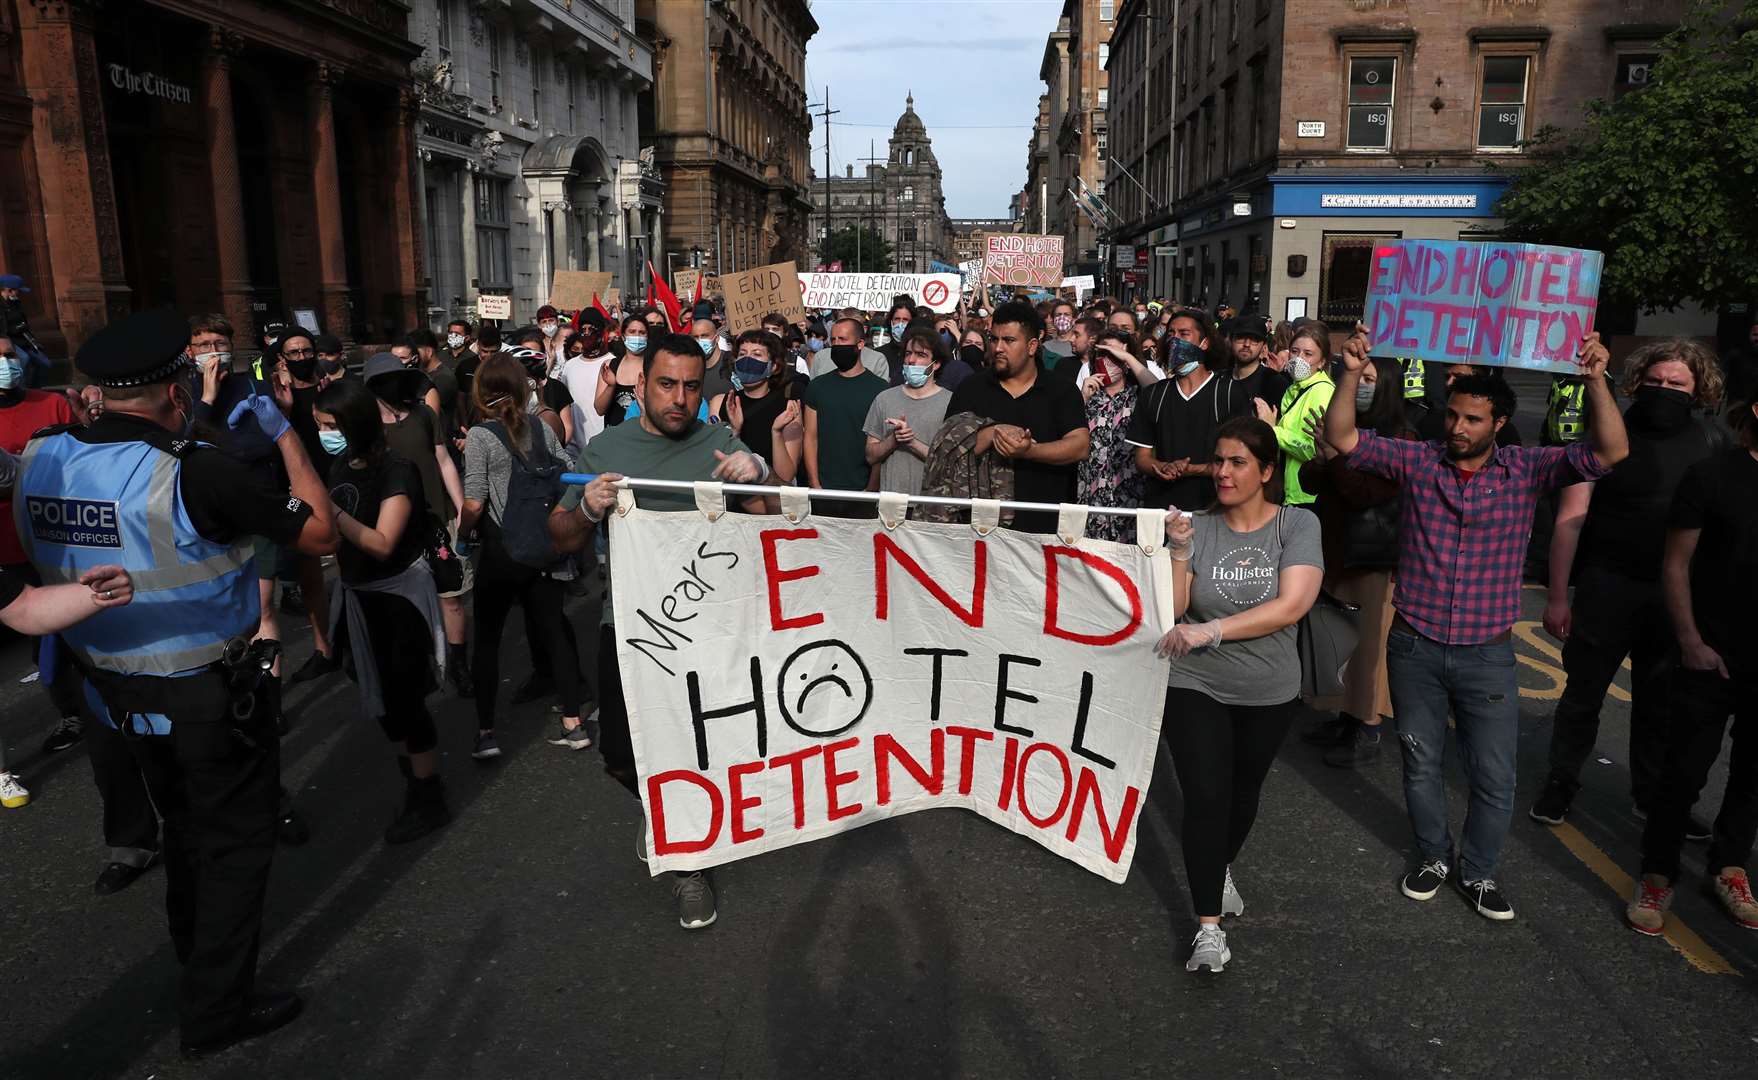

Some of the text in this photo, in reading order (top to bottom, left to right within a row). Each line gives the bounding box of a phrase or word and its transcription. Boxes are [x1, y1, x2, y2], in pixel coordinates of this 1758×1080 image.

[109, 63, 192, 104] The Citizen
[988, 237, 1064, 253] END HOTEL
[986, 253, 1063, 268] DETENTION
[739, 271, 781, 294] END
[811, 274, 831, 289] END
[832, 276, 863, 291] HOTEL
[867, 275, 921, 292] DETENTION
[983, 266, 1060, 285] NOW
[1371, 245, 1598, 308] END HOTEL
[734, 291, 786, 315] HOTEL
[807, 291, 828, 307] END
[1369, 299, 1594, 362] DETENTION
[29, 500, 116, 528] POLICE
[72, 531, 119, 544] OFFICER
[1210, 565, 1275, 581] Hollister
[760, 529, 1144, 646] END
[626, 541, 739, 676] Mears
[647, 727, 1139, 864] DETENTION
